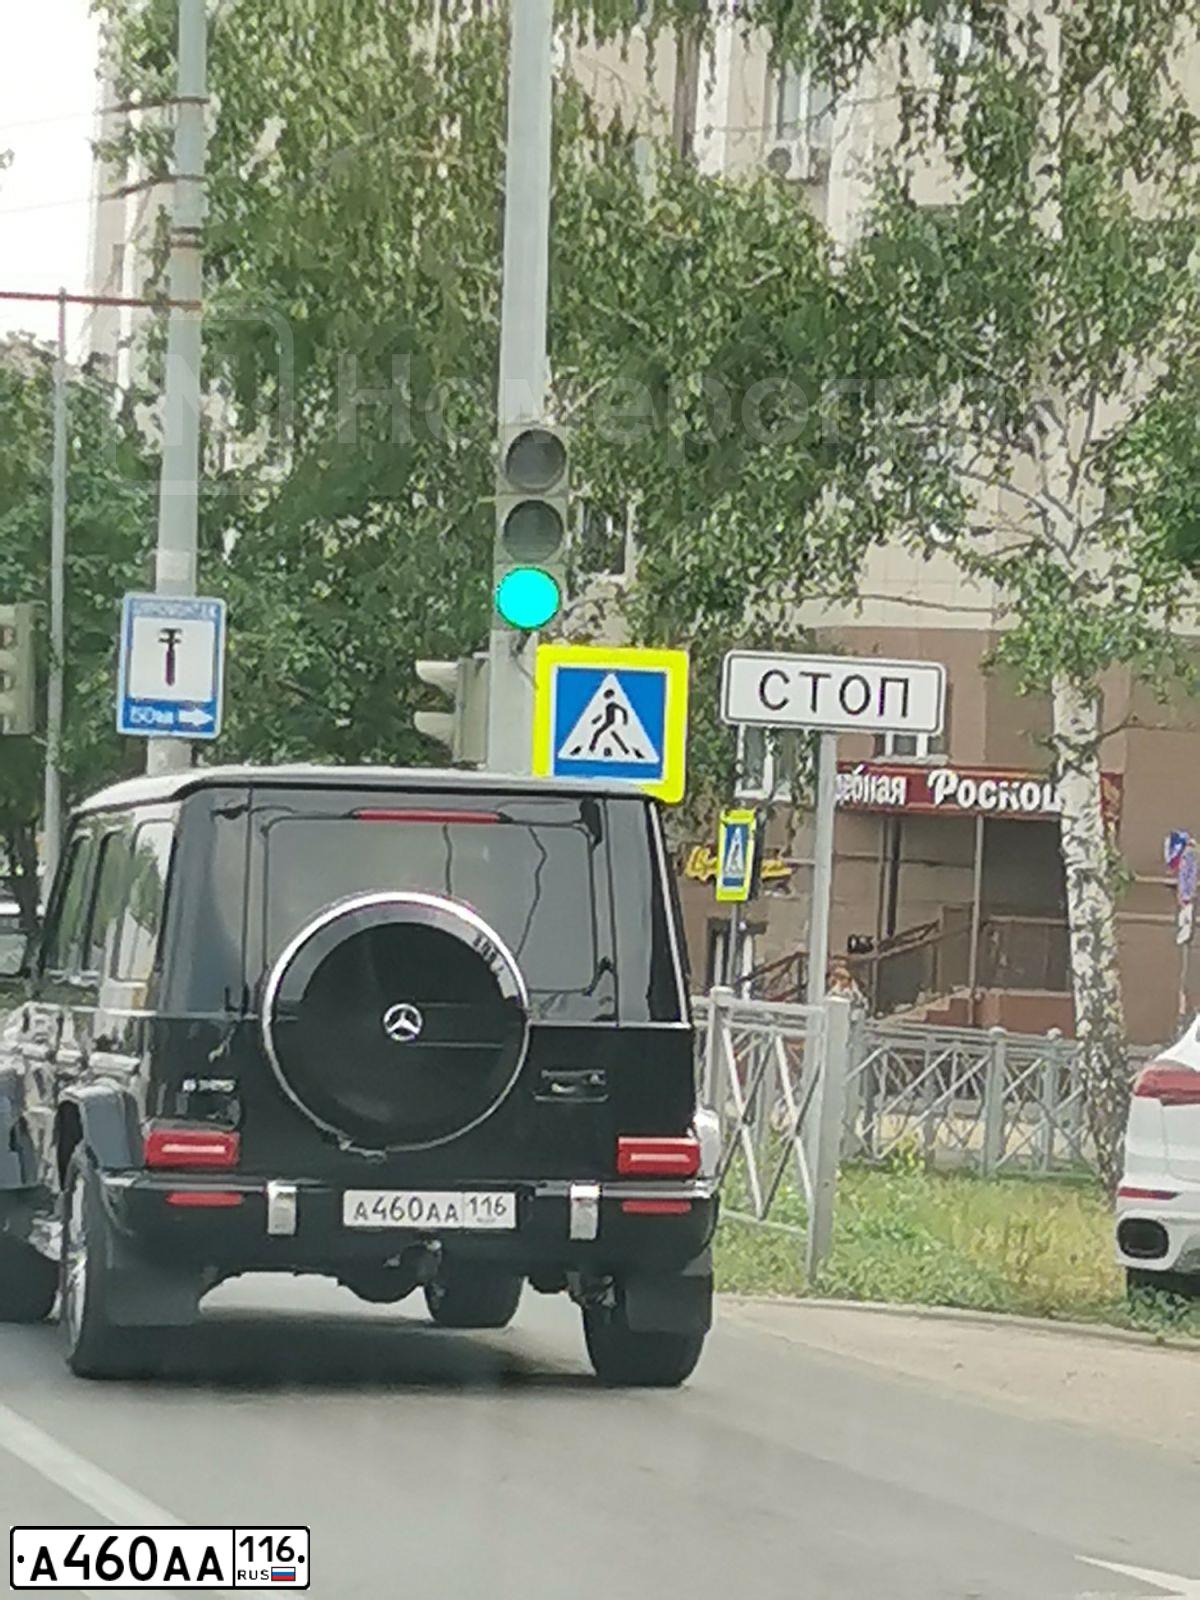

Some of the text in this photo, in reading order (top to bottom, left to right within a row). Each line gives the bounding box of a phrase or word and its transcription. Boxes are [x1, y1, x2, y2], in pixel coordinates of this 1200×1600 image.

[759, 669, 909, 718] СТОП
[354, 1196, 507, 1222] А460АА 116
